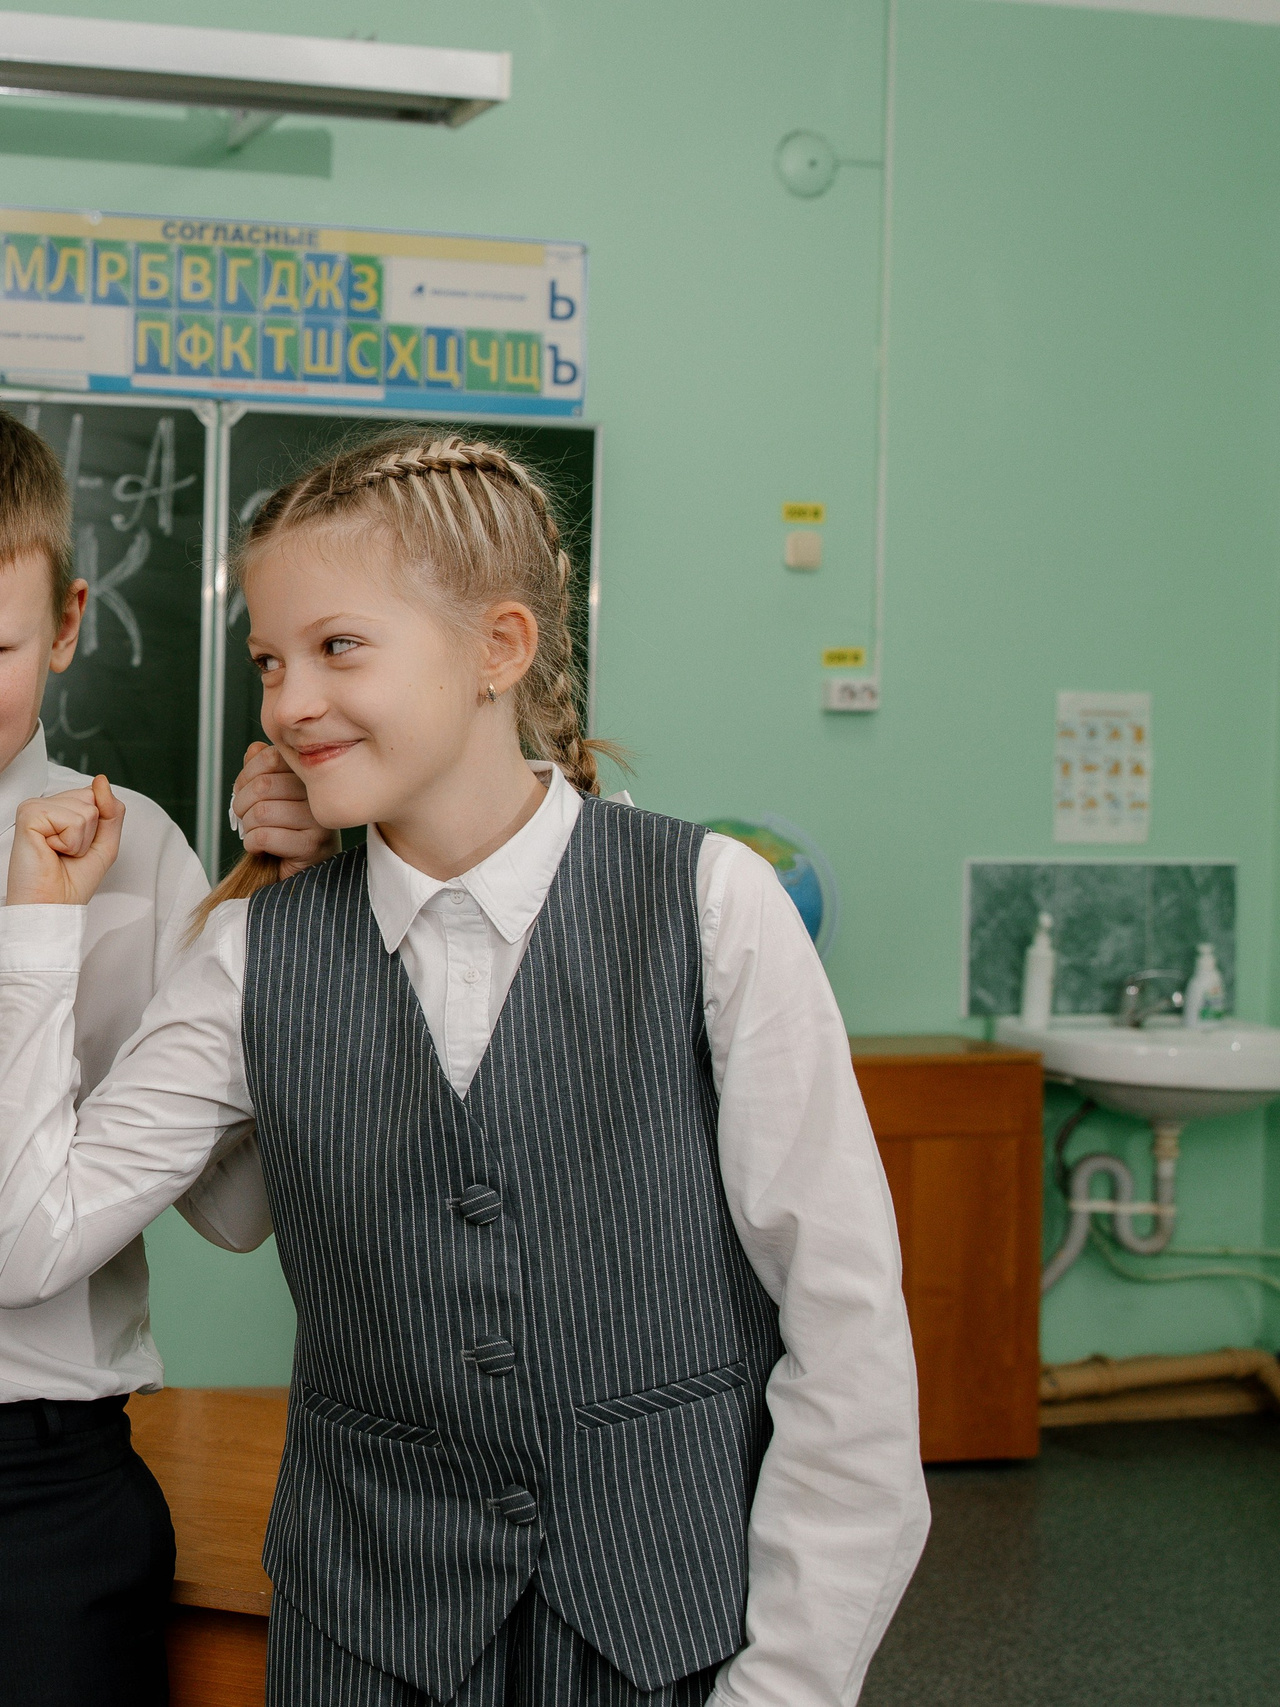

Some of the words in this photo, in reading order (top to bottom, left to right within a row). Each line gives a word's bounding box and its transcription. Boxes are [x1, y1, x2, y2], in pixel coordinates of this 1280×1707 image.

[161, 221, 319, 248] СОГЛАСНЫЕ
[549, 279, 576, 322] Ь
[547, 344, 577, 385] Ъ
